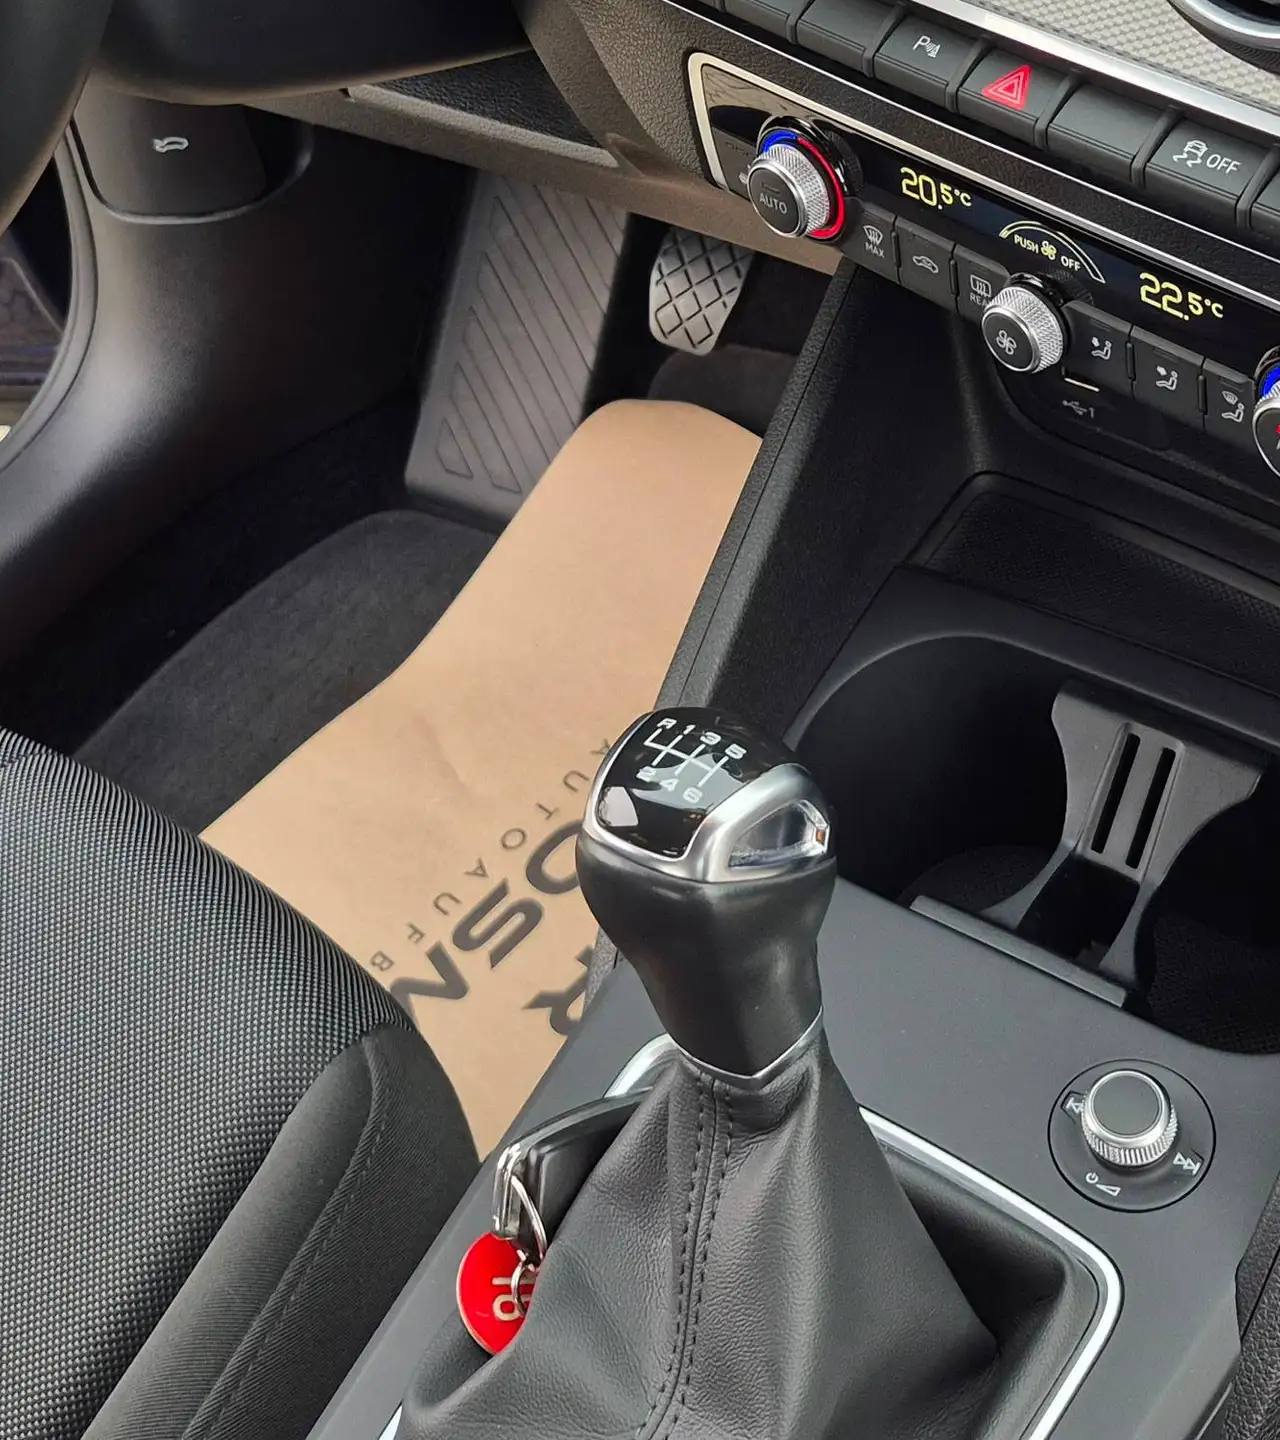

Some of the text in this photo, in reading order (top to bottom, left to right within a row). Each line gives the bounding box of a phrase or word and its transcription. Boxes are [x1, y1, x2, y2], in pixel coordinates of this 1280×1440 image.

[1206, 153, 1241, 175] OFF
[758, 192, 788, 214] AUTO
[865, 242, 885, 259] MAX
[1014, 234, 1081, 271] PUSH OFF
[656, 717, 747, 760] R 1 3 5
[636, 765, 703, 804] 2 4 6
